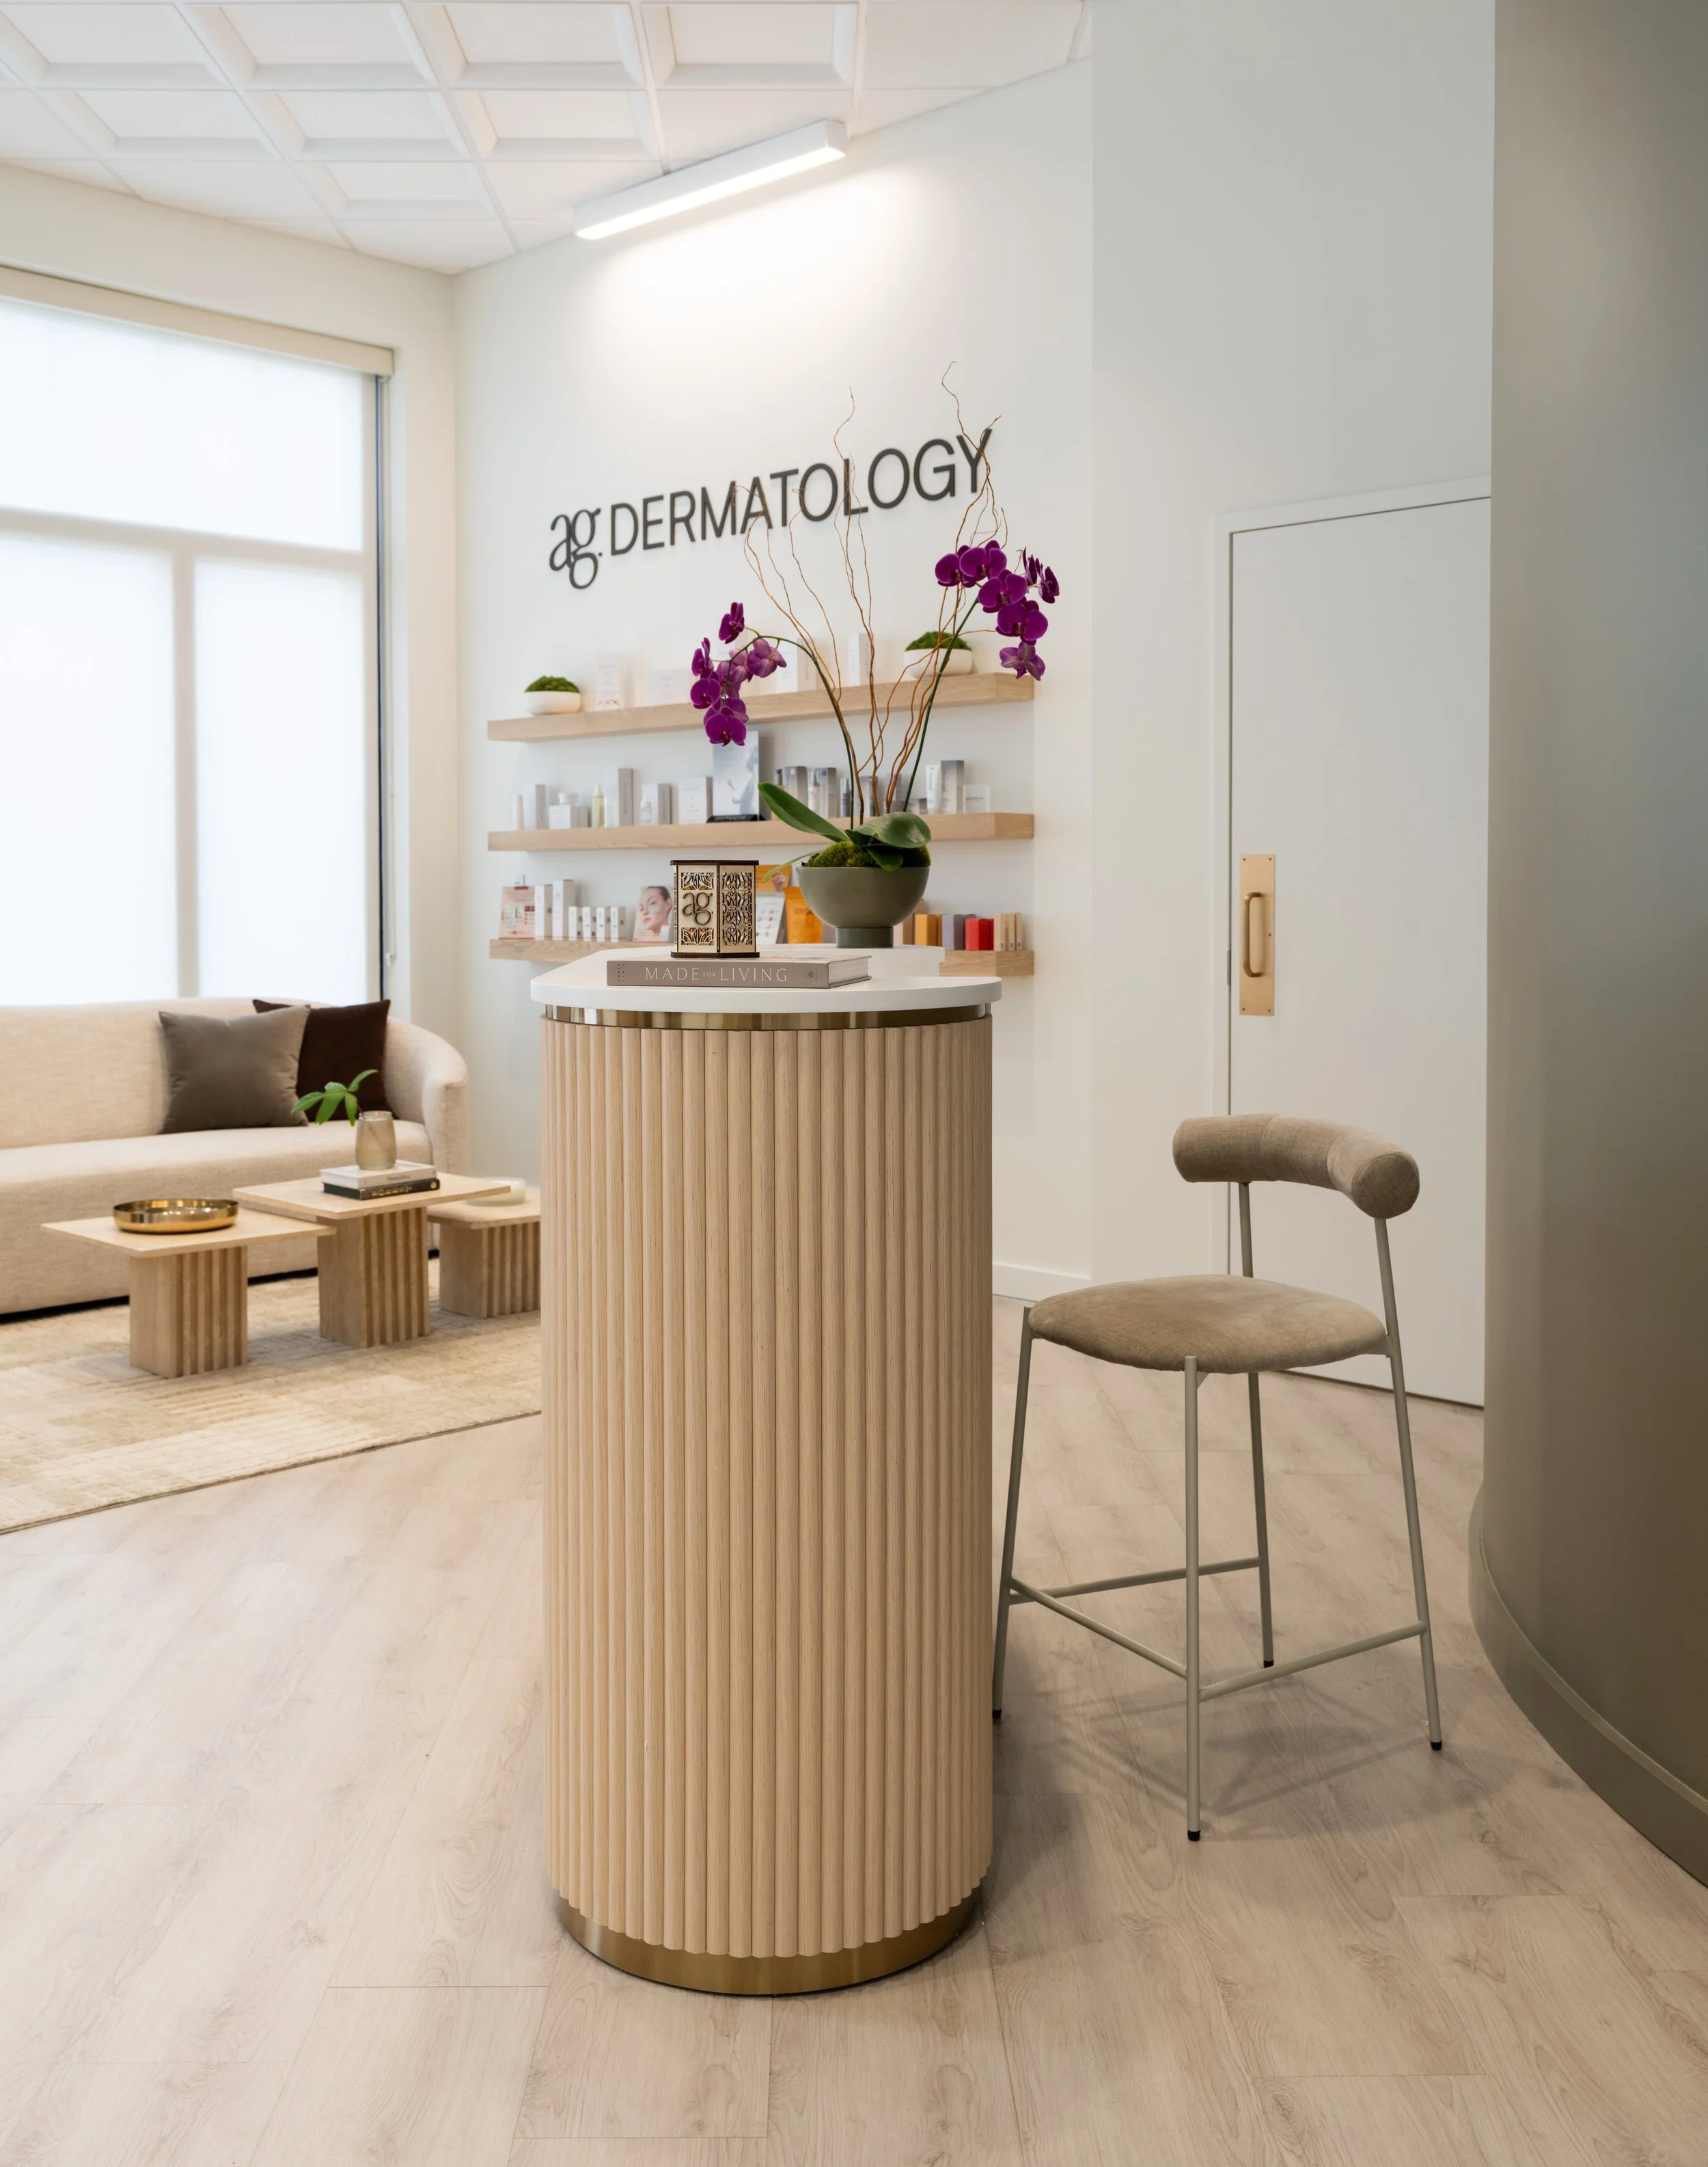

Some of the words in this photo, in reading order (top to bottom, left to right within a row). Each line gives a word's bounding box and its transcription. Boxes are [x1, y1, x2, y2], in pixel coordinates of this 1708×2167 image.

[611, 428, 992, 556] DERMATOLOGY
[645, 967, 700, 981] MADE
[720, 968, 788, 982] LIVING
